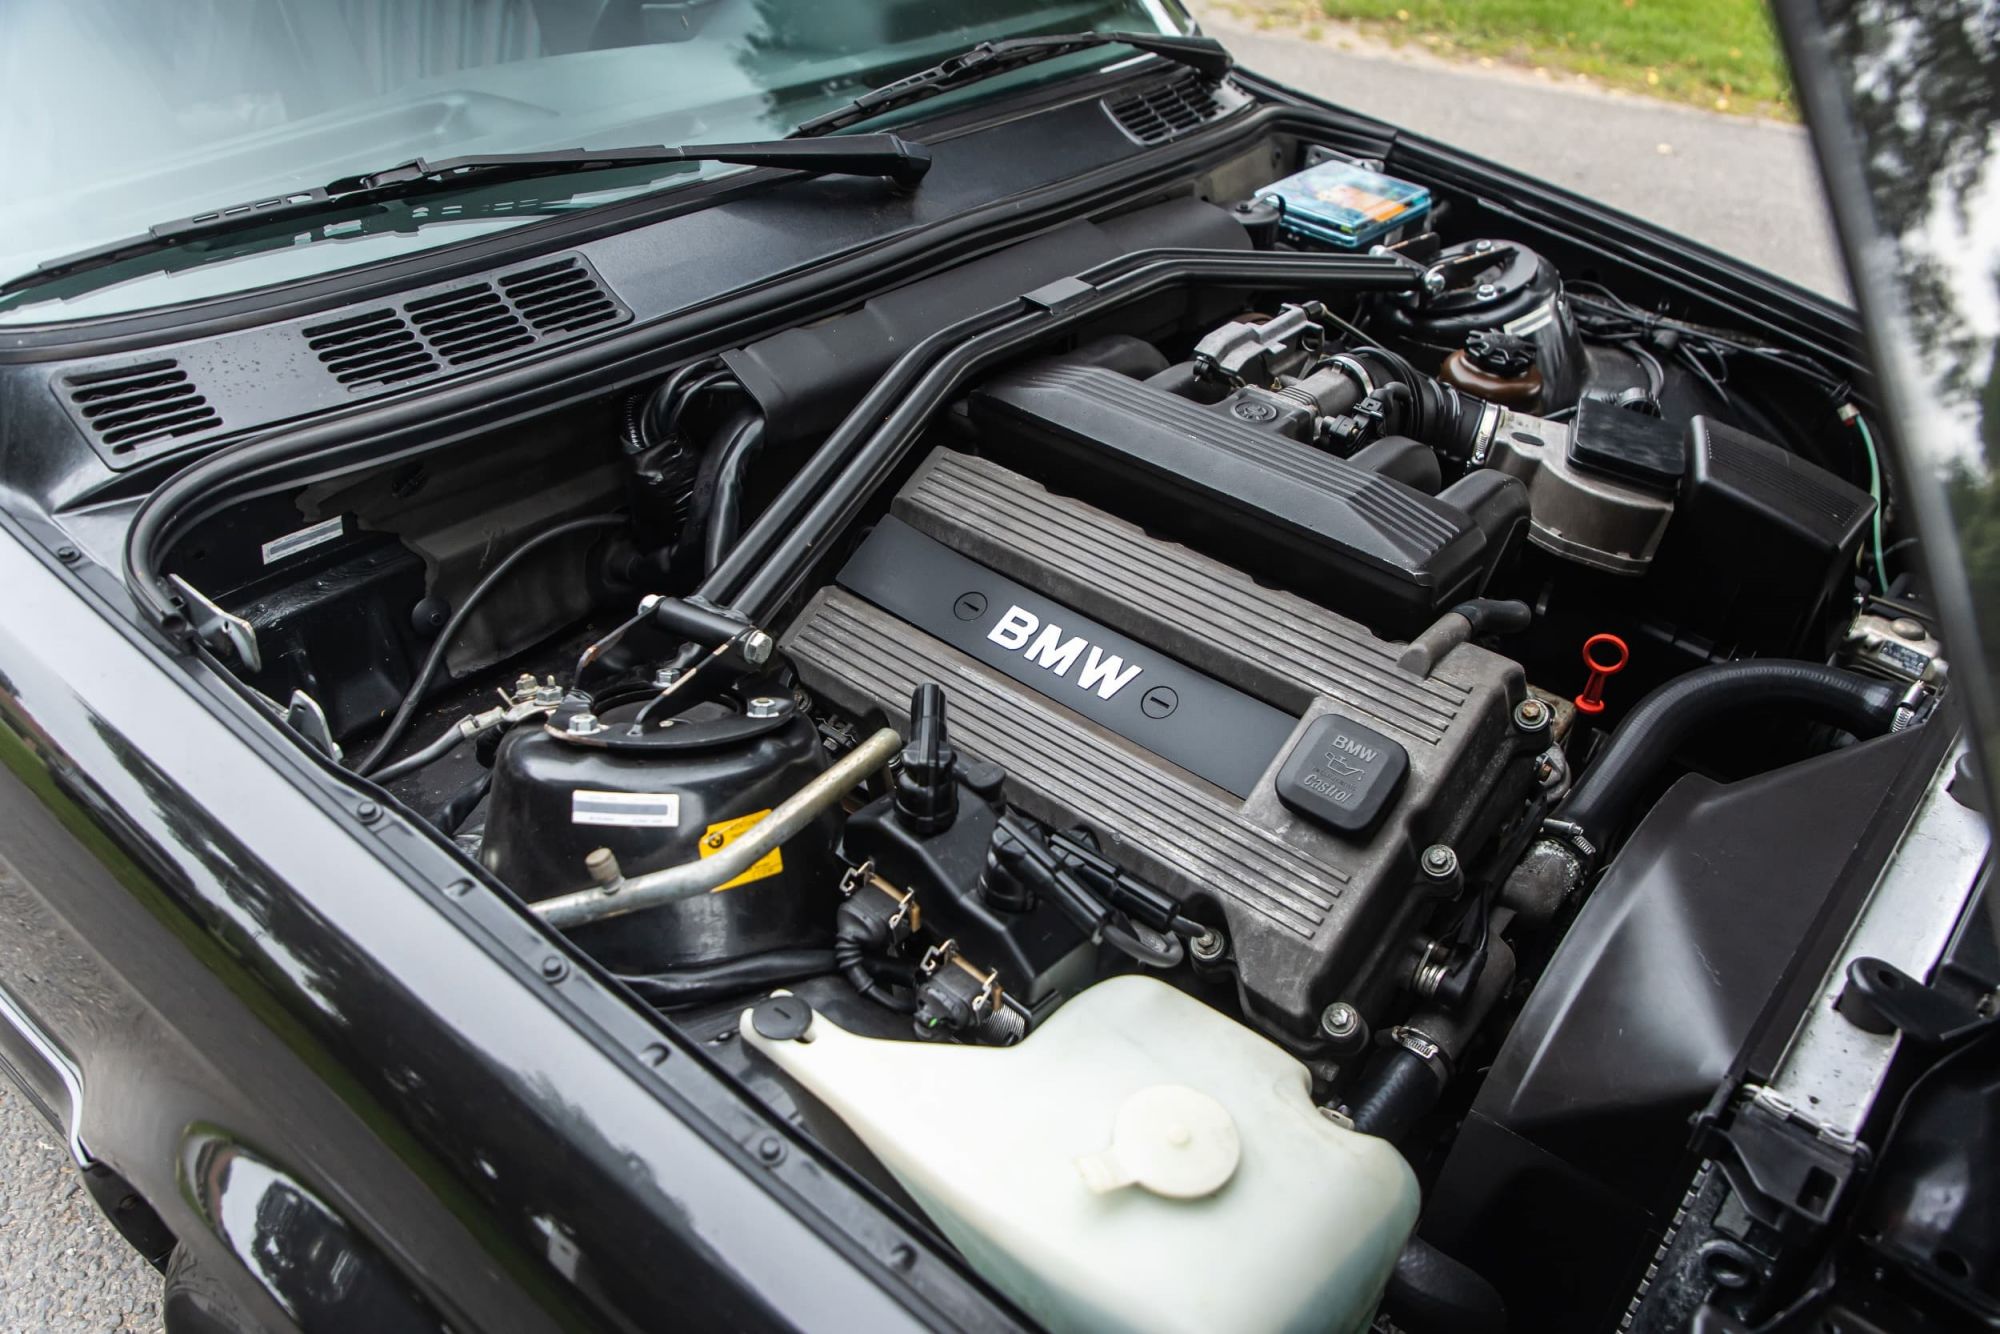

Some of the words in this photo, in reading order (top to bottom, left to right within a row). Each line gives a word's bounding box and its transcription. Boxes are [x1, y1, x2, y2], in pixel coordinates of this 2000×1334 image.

[987, 604, 1144, 700] BMW
[1332, 734, 1378, 762] BMW
[1303, 774, 1354, 802] Castrol
